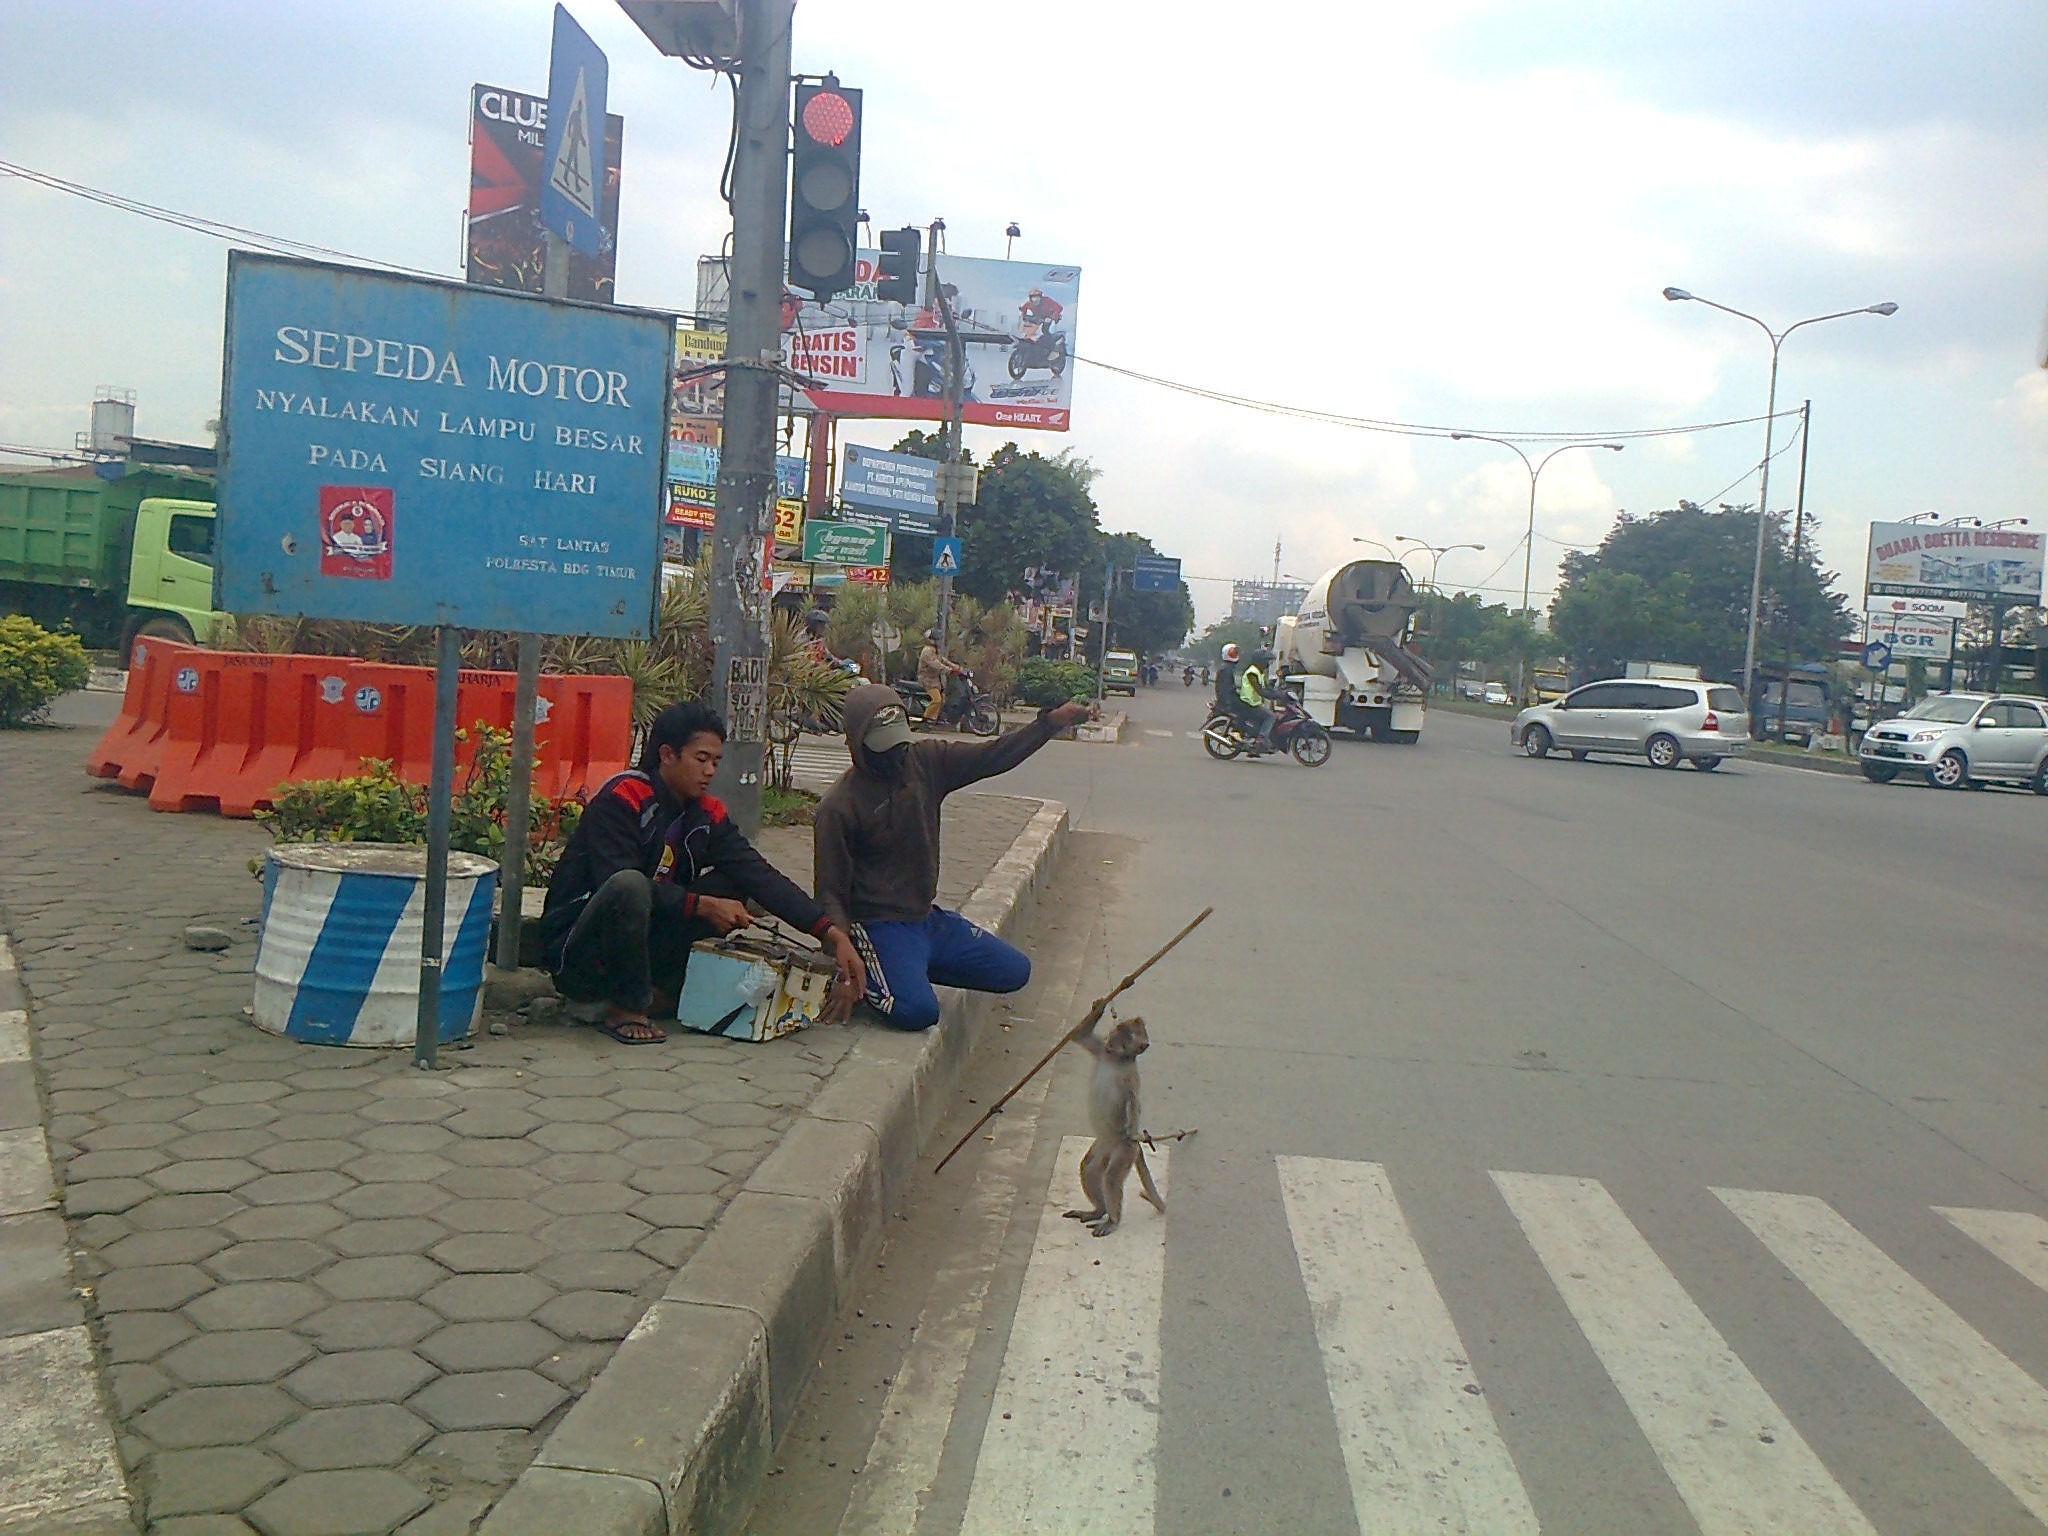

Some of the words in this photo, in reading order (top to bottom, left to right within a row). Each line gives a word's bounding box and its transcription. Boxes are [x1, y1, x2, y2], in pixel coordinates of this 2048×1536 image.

[792, 331, 856, 352] GRATIS
[275, 326, 464, 386] SEPEDA
[486, 355, 631, 409] MOTOR
[255, 389, 419, 428] NYALAKAN
[438, 412, 536, 441] LAMPU
[556, 426, 644, 455] BESAR
[308, 445, 389, 473] PADA
[419, 457, 505, 486] SIANG
[534, 470, 597, 495] HARI
[674, 485, 706, 500] RUKO
[780, 481, 795, 496] 15
[557, 538, 610, 553] LANTAS
[1884, 633, 1935, 647] BGR
